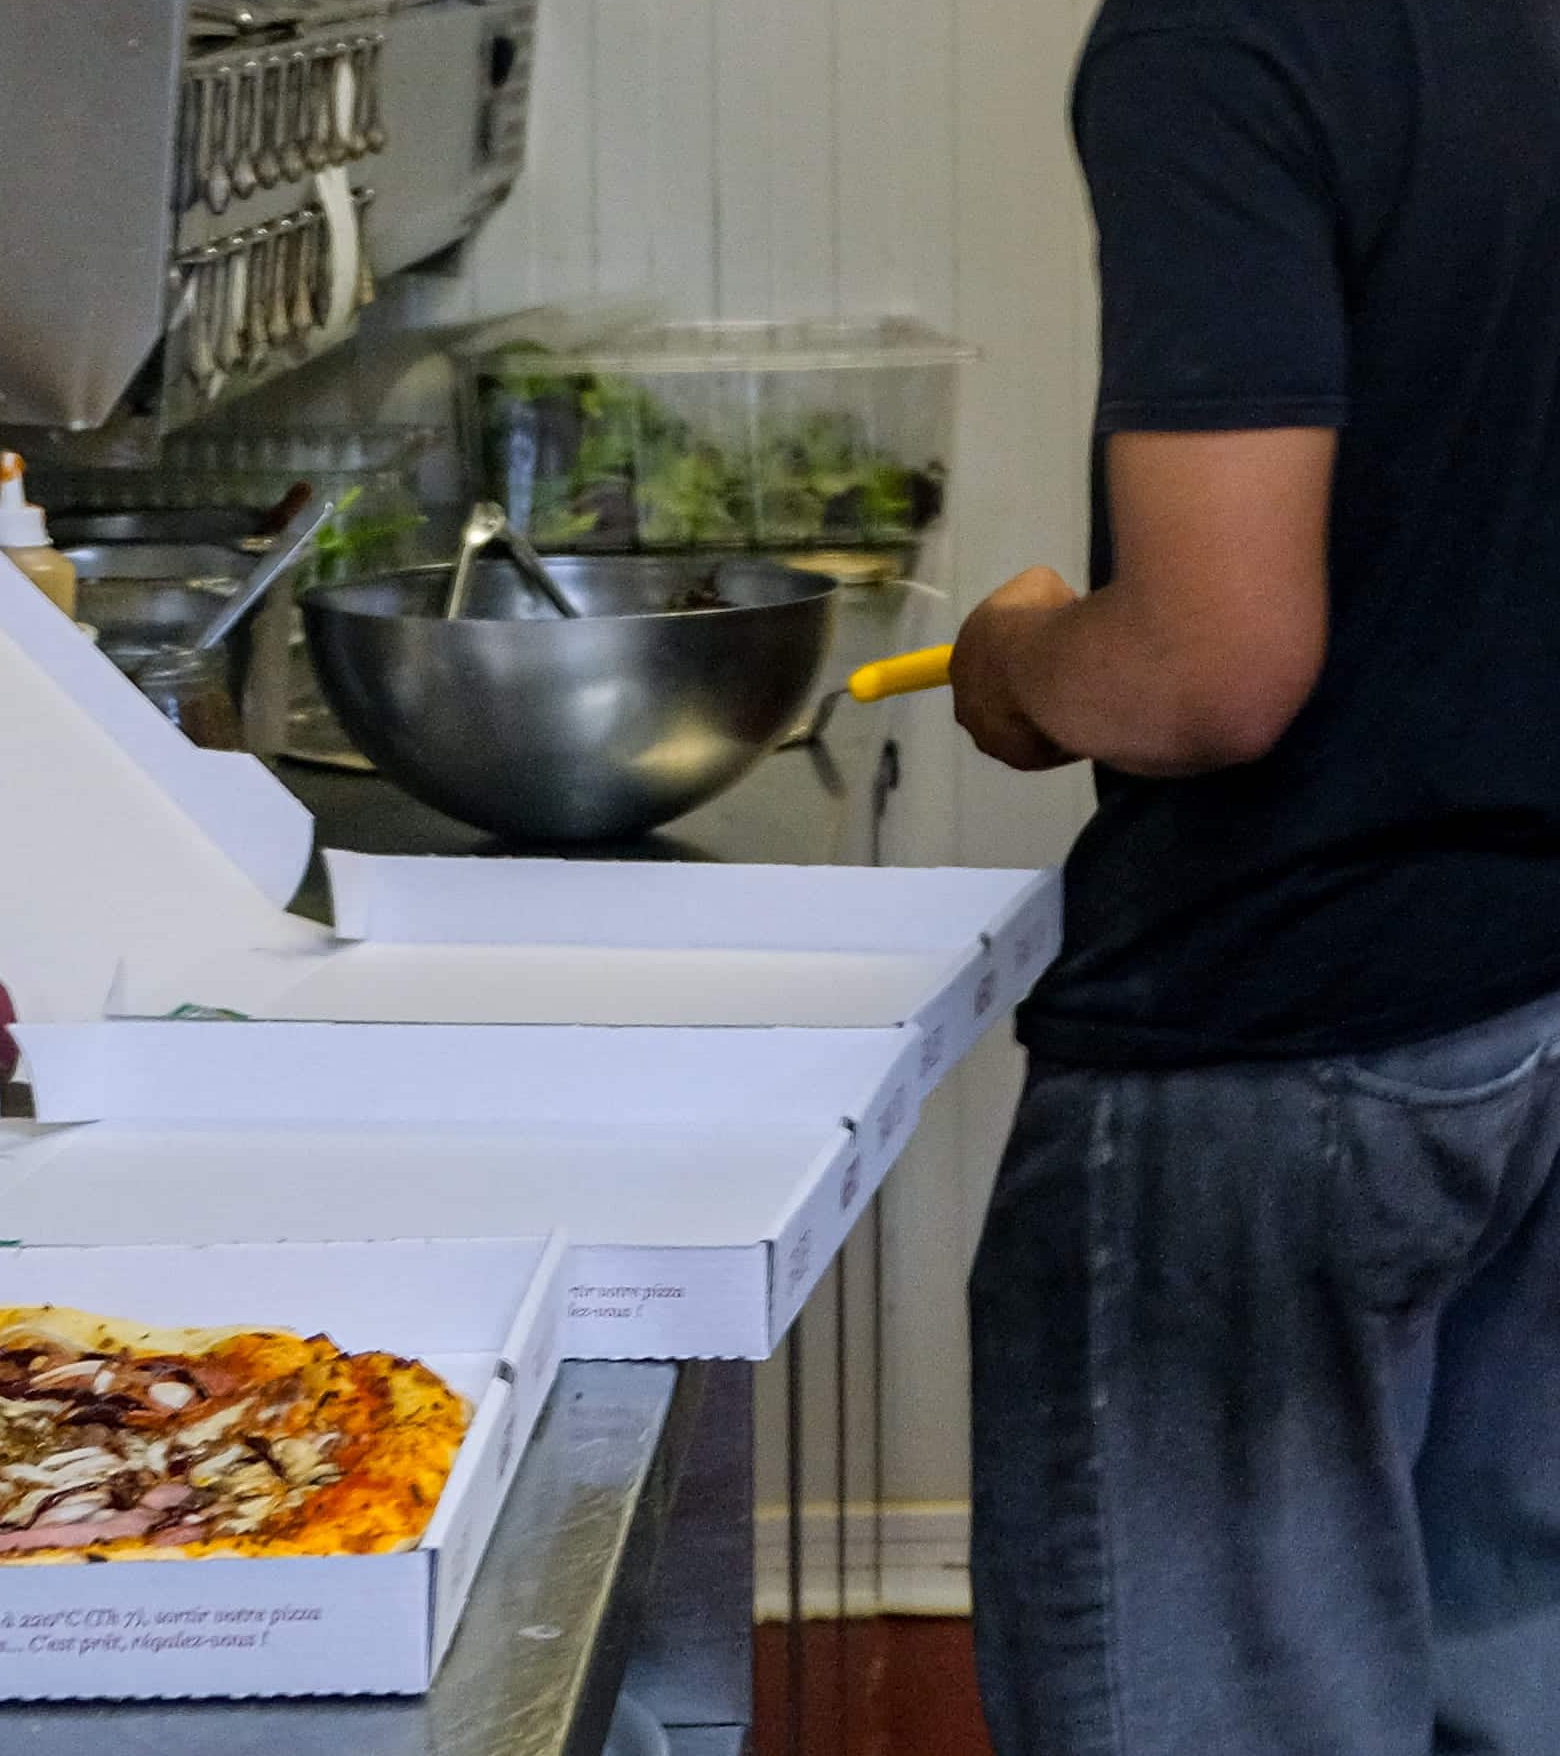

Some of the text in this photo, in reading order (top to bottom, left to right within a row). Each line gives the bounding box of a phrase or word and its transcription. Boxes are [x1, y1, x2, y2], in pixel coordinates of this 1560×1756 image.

[641, 1282, 686, 1301] pizza
[16, 1610, 83, 1629] 220°C
[84, 1608, 120, 1628] (Th
[153, 1605, 210, 1625] sortir
[212, 1609, 265, 1623] votre
[267, 1604, 322, 1626] pizza
[26, 1634, 76, 1653] C'est
[77, 1631, 127, 1656] prêt,
[130, 1630, 255, 1654] régalez-vous
